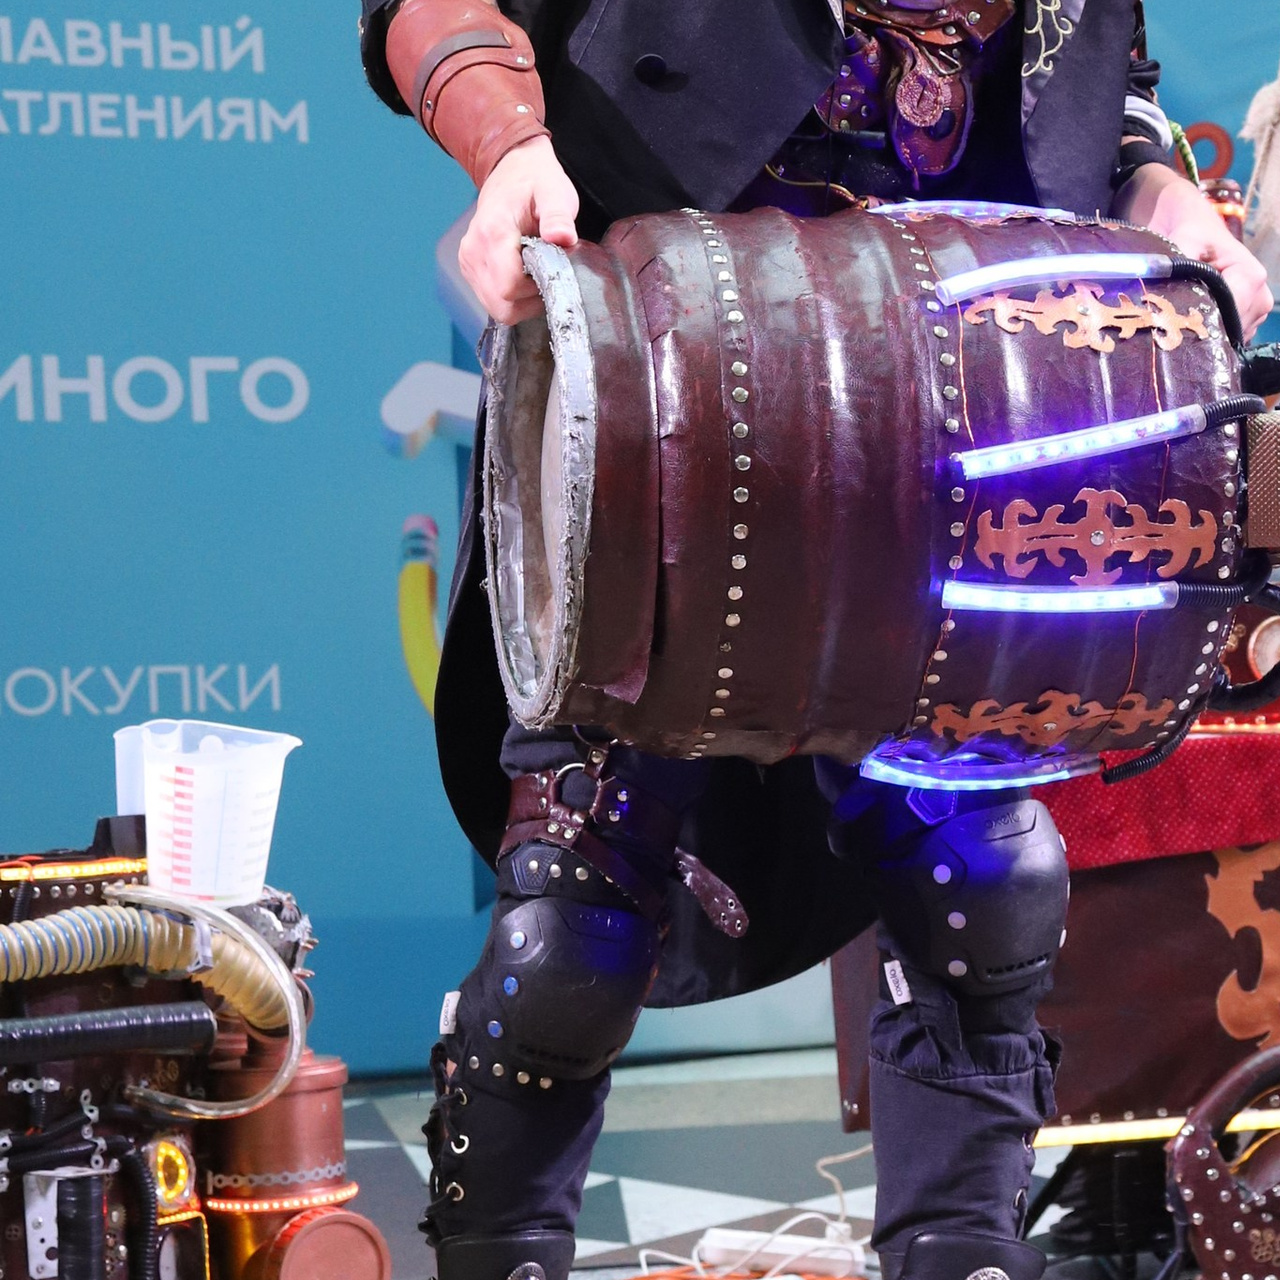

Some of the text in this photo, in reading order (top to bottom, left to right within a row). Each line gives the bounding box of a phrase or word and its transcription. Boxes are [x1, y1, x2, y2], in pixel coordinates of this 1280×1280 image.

[0, 89, 311, 144] ТЛЕНИЯМ
[0, 662, 282, 716] ОКУПКИ
[889, 968, 904, 997] oxelo
